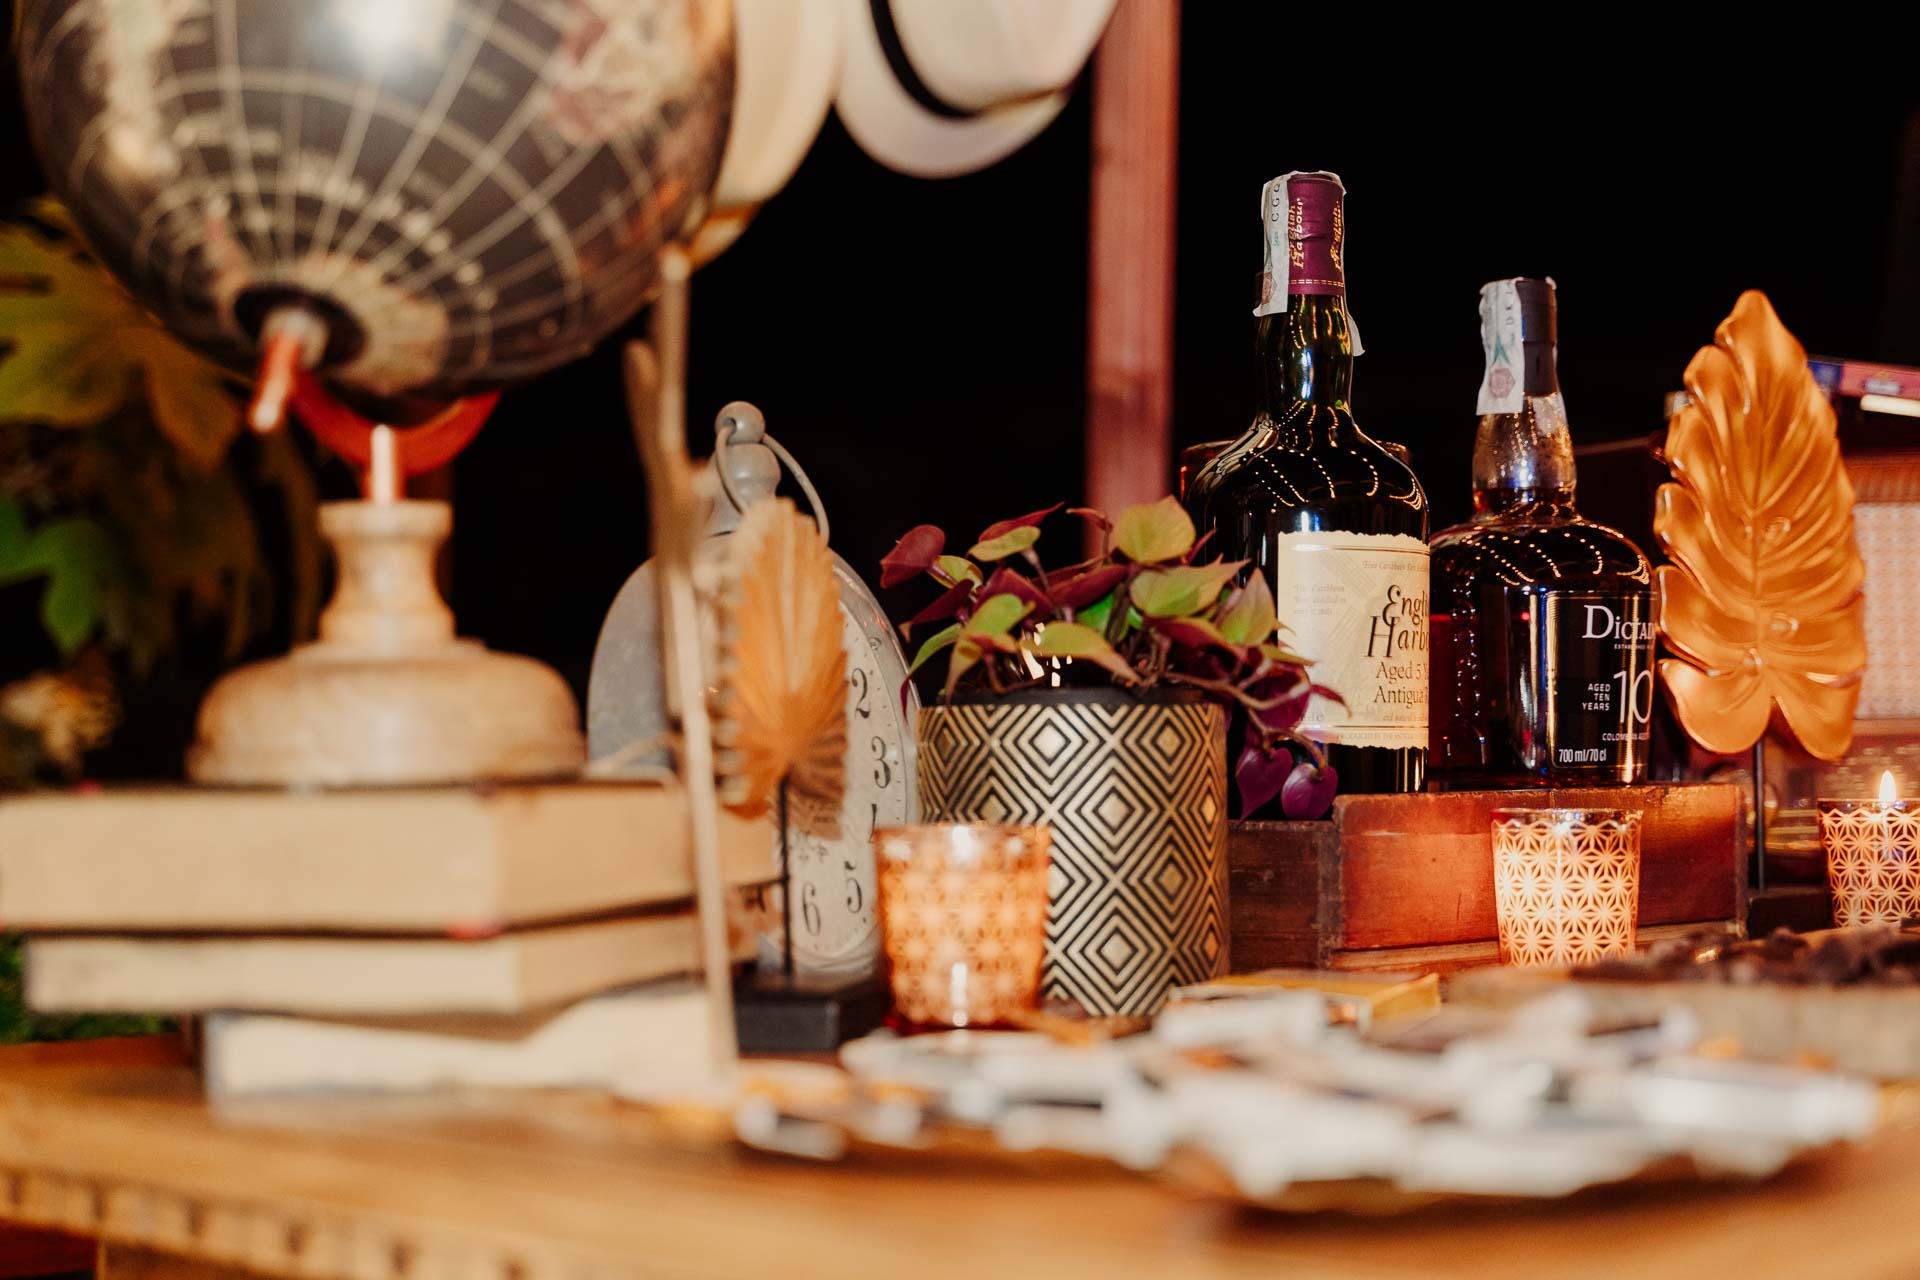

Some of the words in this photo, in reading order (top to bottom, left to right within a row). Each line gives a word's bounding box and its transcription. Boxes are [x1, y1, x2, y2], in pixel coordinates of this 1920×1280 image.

[1375, 660, 1413, 685] Aged
[1415, 663, 1422, 680] 5
[851, 666, 871, 719] 2
[1373, 685, 1423, 709] Antigua
[1587, 683, 1611, 692] AGED
[1593, 692, 1610, 702] TEN
[1613, 669, 1654, 724] 10
[1581, 702, 1610, 711] YEARS
[871, 735, 891, 789] 3
[1558, 748, 1574, 763] 700
[1574, 748, 1599, 762] ml/70
[1599, 747, 1607, 762] cl
[844, 860, 863, 914] 5
[801, 881, 821, 936] 6
